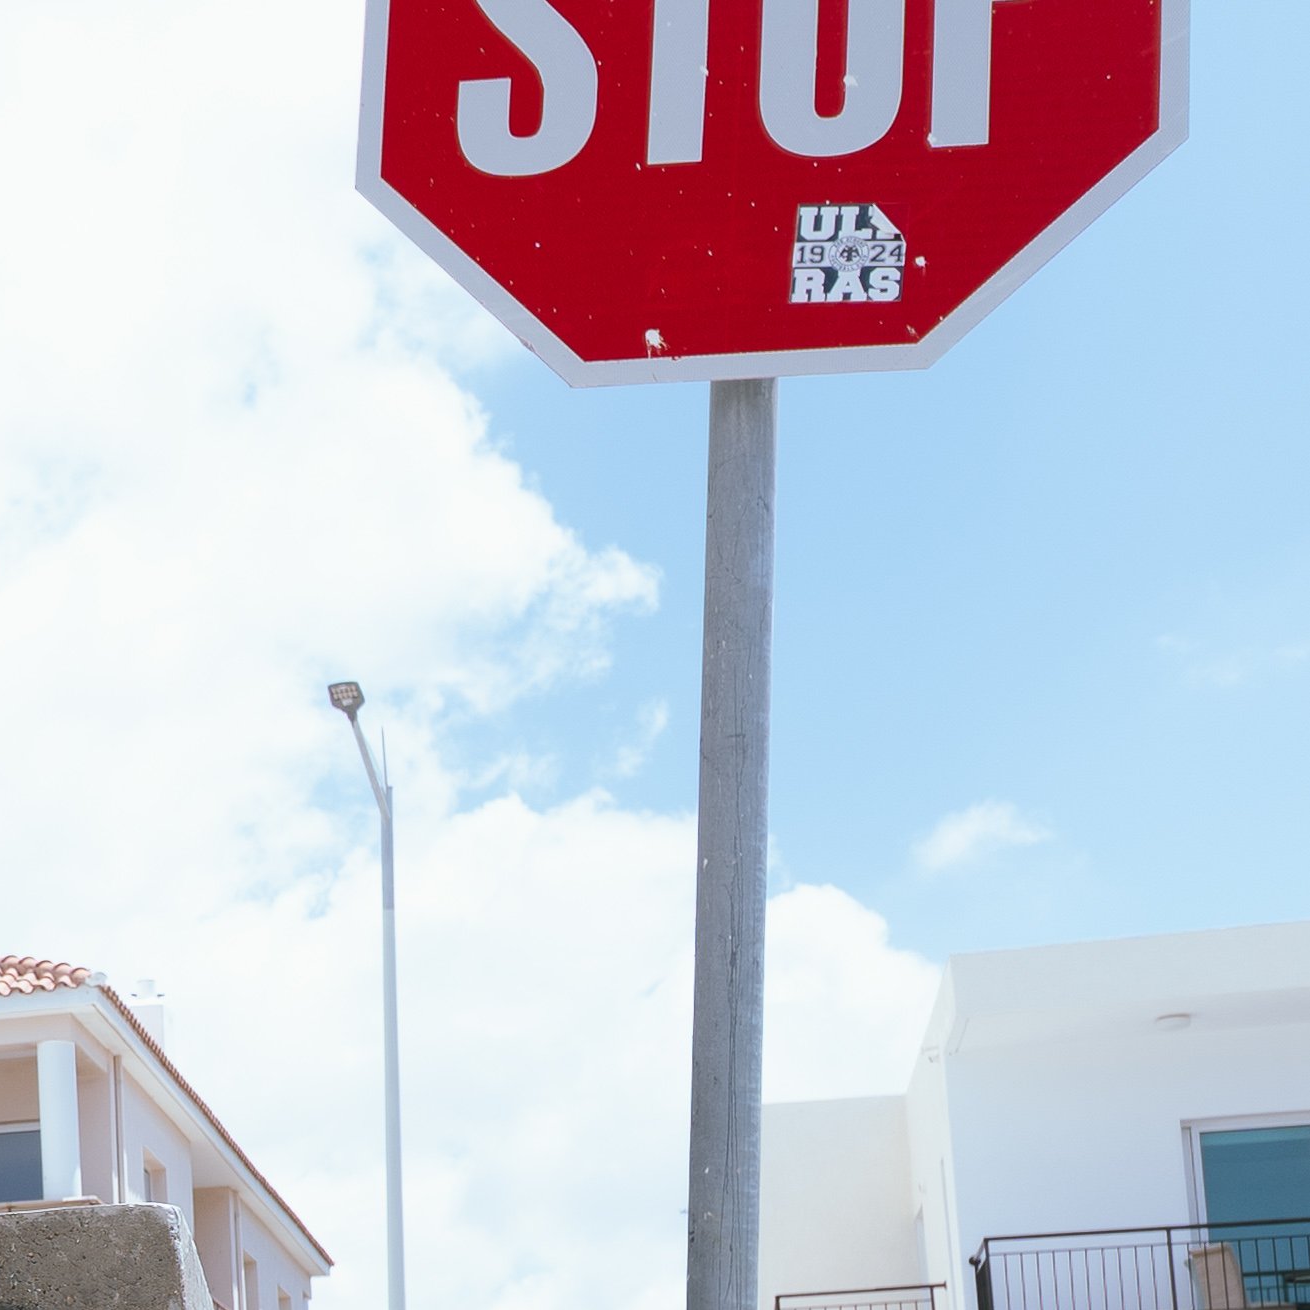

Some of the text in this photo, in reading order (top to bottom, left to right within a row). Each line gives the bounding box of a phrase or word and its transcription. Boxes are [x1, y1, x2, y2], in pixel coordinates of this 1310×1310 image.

[797, 245, 825, 264] 19
[871, 244, 902, 263] 24
[792, 267, 901, 303] RAS
